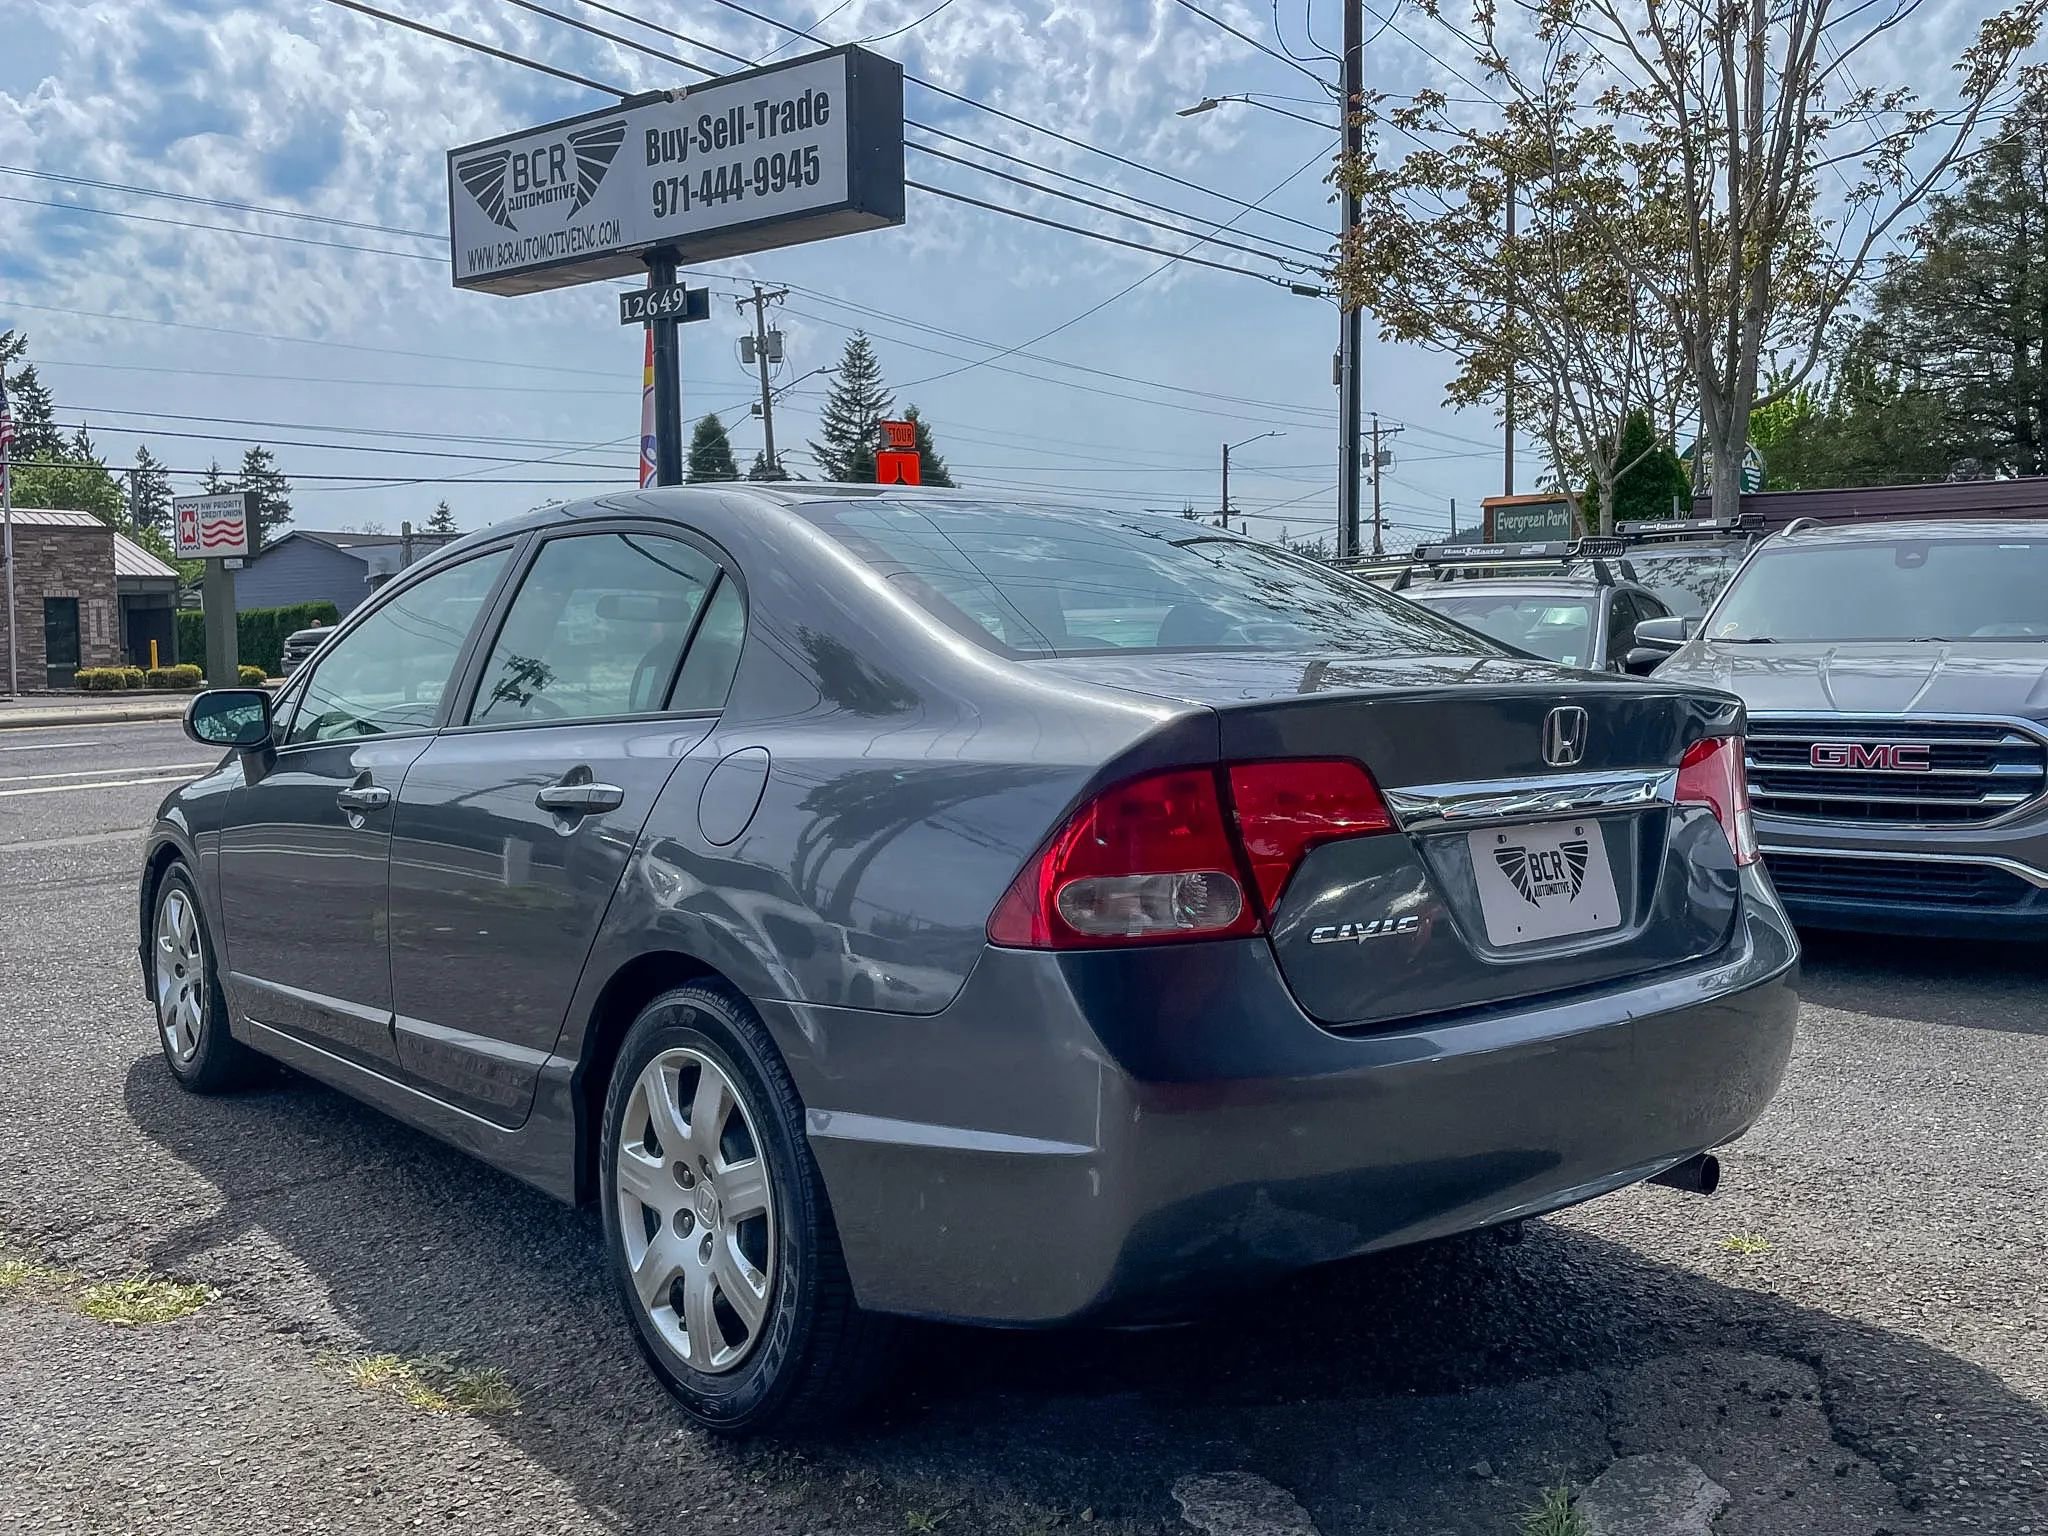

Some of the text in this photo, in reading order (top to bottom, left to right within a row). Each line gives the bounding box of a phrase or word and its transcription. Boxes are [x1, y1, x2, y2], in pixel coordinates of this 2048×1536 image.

[645, 88, 830, 167] Buy-Sell-Trade
[512, 142, 567, 193] BCR
[652, 144, 820, 219] 971-444-9945
[508, 182, 576, 212] AUTOMOTIVE
[467, 218, 621, 272] WWW.BCRAUTOMOTIVEINC.COM
[622, 287, 684, 320] 12649
[201, 510, 222, 519] CREDIT
[213, 500, 242, 509] PRIORITY
[1497, 508, 1569, 533] Evergreen Park
[1810, 743, 1930, 770] GMC
[1527, 850, 1566, 883] BCR
[1533, 881, 1571, 898] AUTOMOTIVE
[1310, 915, 1419, 944] CIVIC
